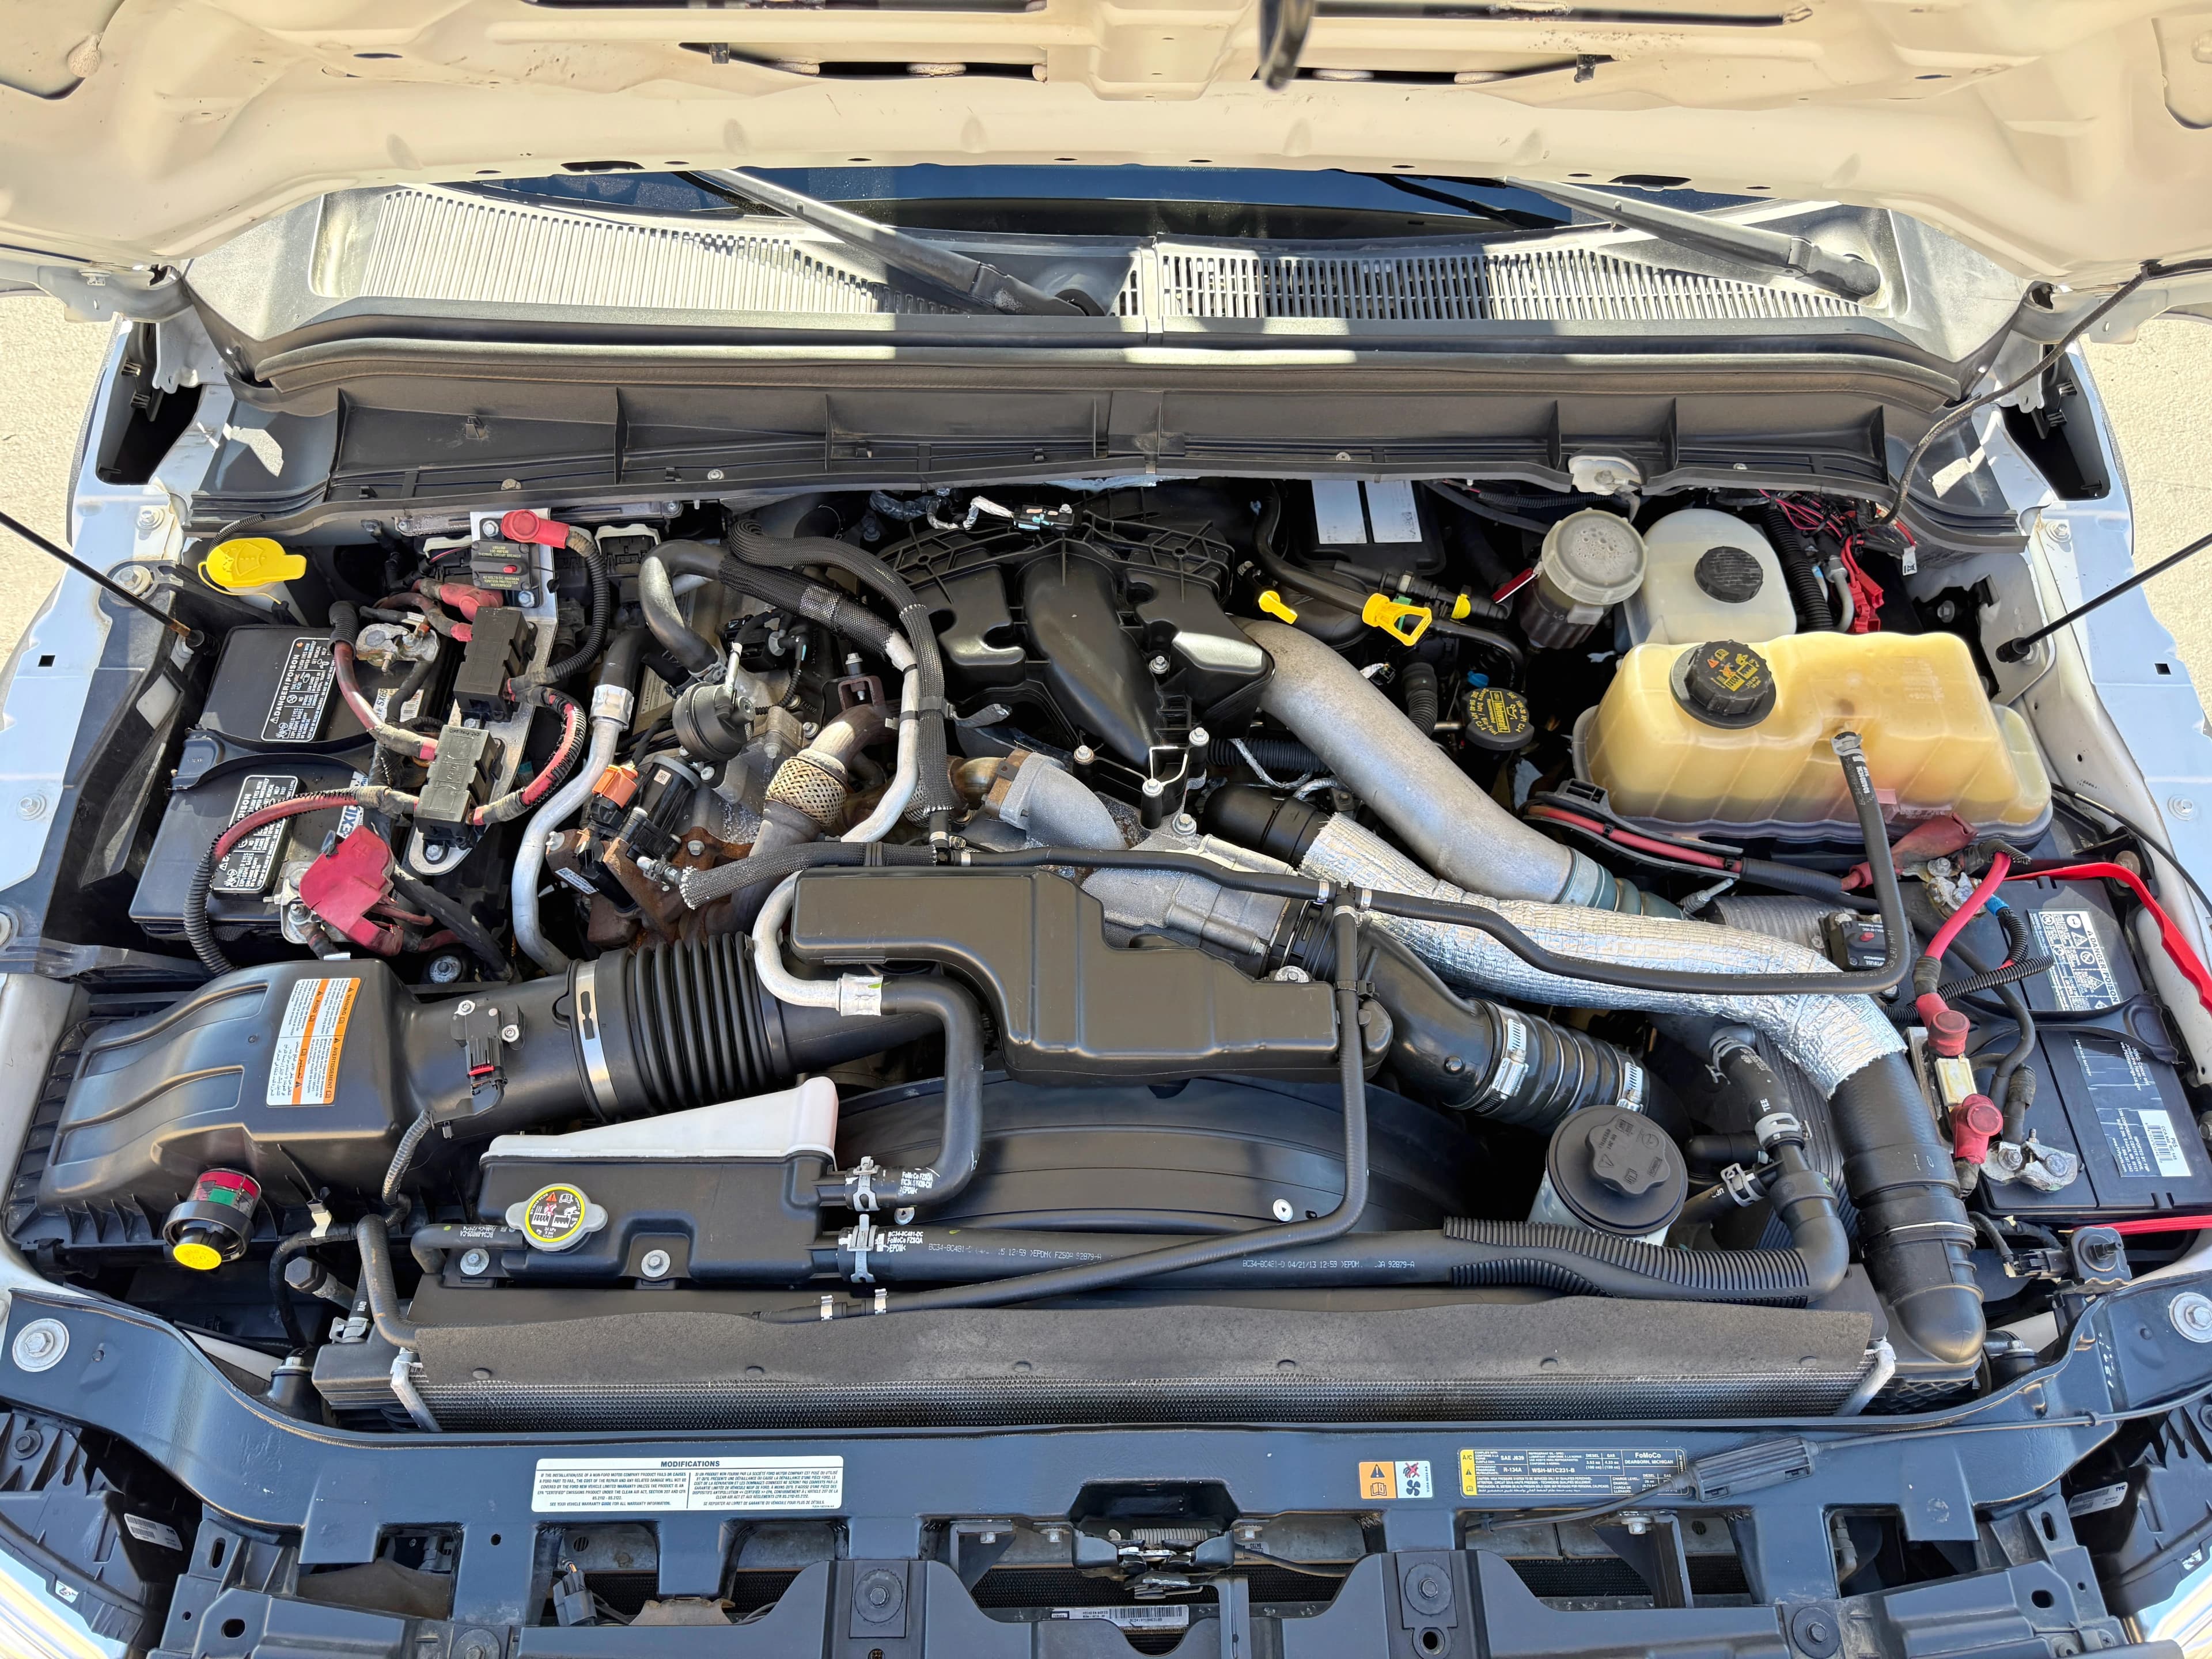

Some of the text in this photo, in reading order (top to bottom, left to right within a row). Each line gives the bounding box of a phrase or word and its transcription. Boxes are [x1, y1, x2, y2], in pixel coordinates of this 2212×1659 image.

[274, 654, 300, 716] DANGER/POISON
[377, 688, 388, 706] SX65
[1494, 702, 1509, 732] Motorcraft
[340, 806, 358, 833] EXID
[2090, 938, 2118, 1002] DANGER/POISON
[313, 999, 321, 1013] AVISO
[342, 995, 352, 1015] WARNING
[327, 1047, 338, 1089] AVERTISSEMENT
[2083, 1060, 2092, 1077] BATTERY
[2138, 1062, 2146, 1077] Cancer
[1760, 1098, 1771, 1112] TEE
[2120, 1117, 2134, 1140] CORPORATE
[2130, 1141, 2138, 1156] CENTER
[2134, 1137, 2143, 1156] IMPORTED
[357, 1301, 367, 1311] RAD
